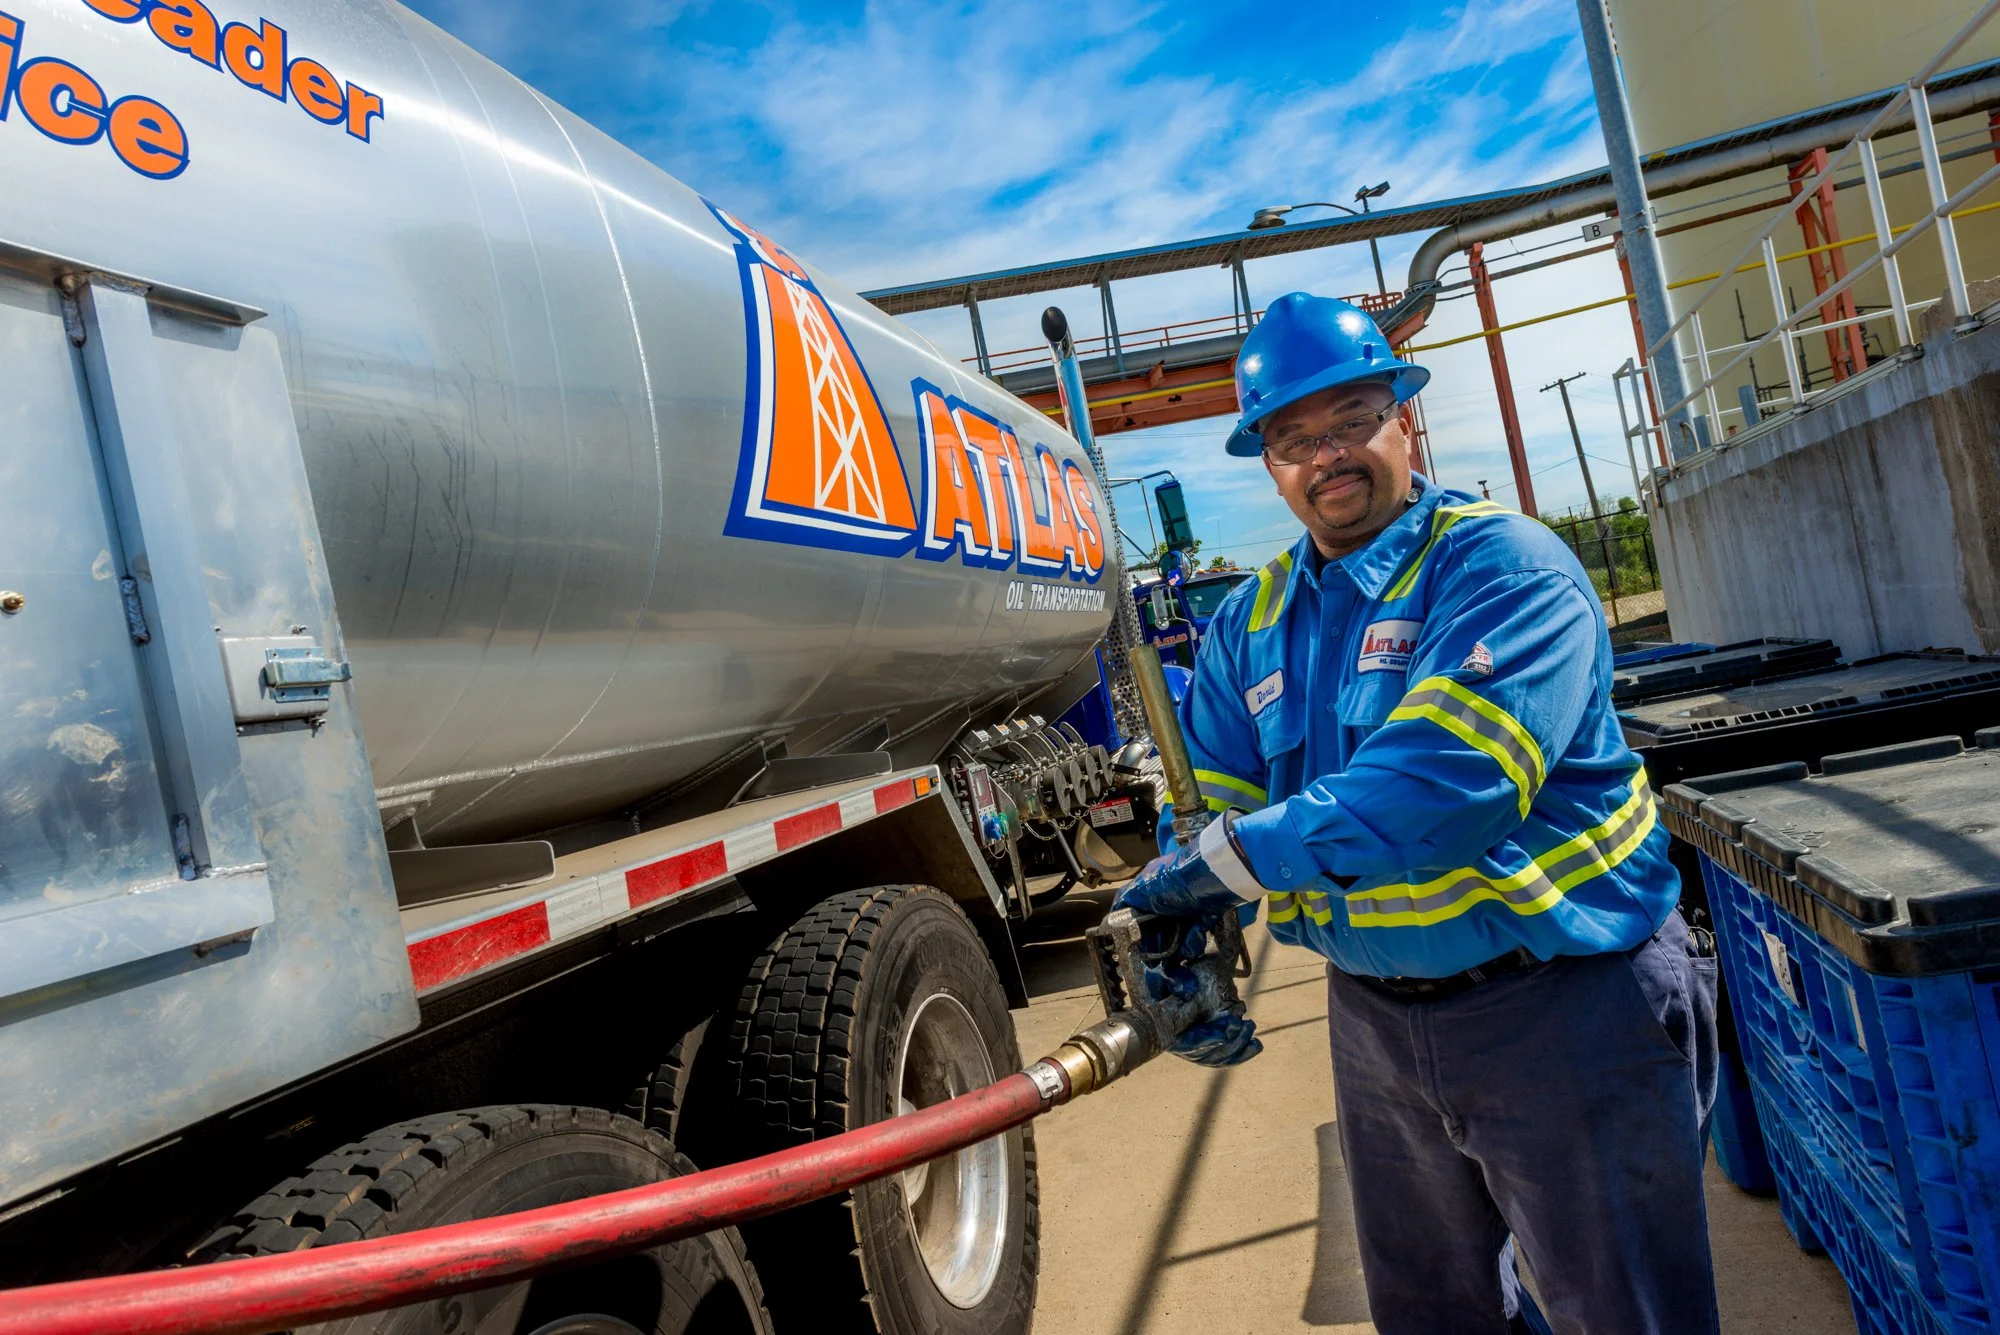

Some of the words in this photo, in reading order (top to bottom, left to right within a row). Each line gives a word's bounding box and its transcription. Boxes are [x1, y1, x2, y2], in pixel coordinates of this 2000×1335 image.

[1592, 224, 1601, 238] B
[912, 378, 1105, 584] ATLAS
[1005, 580, 1025, 611] OIL
[1029, 583, 1106, 612] TRANSPORTATION
[1374, 637, 1418, 655] ATLAS
